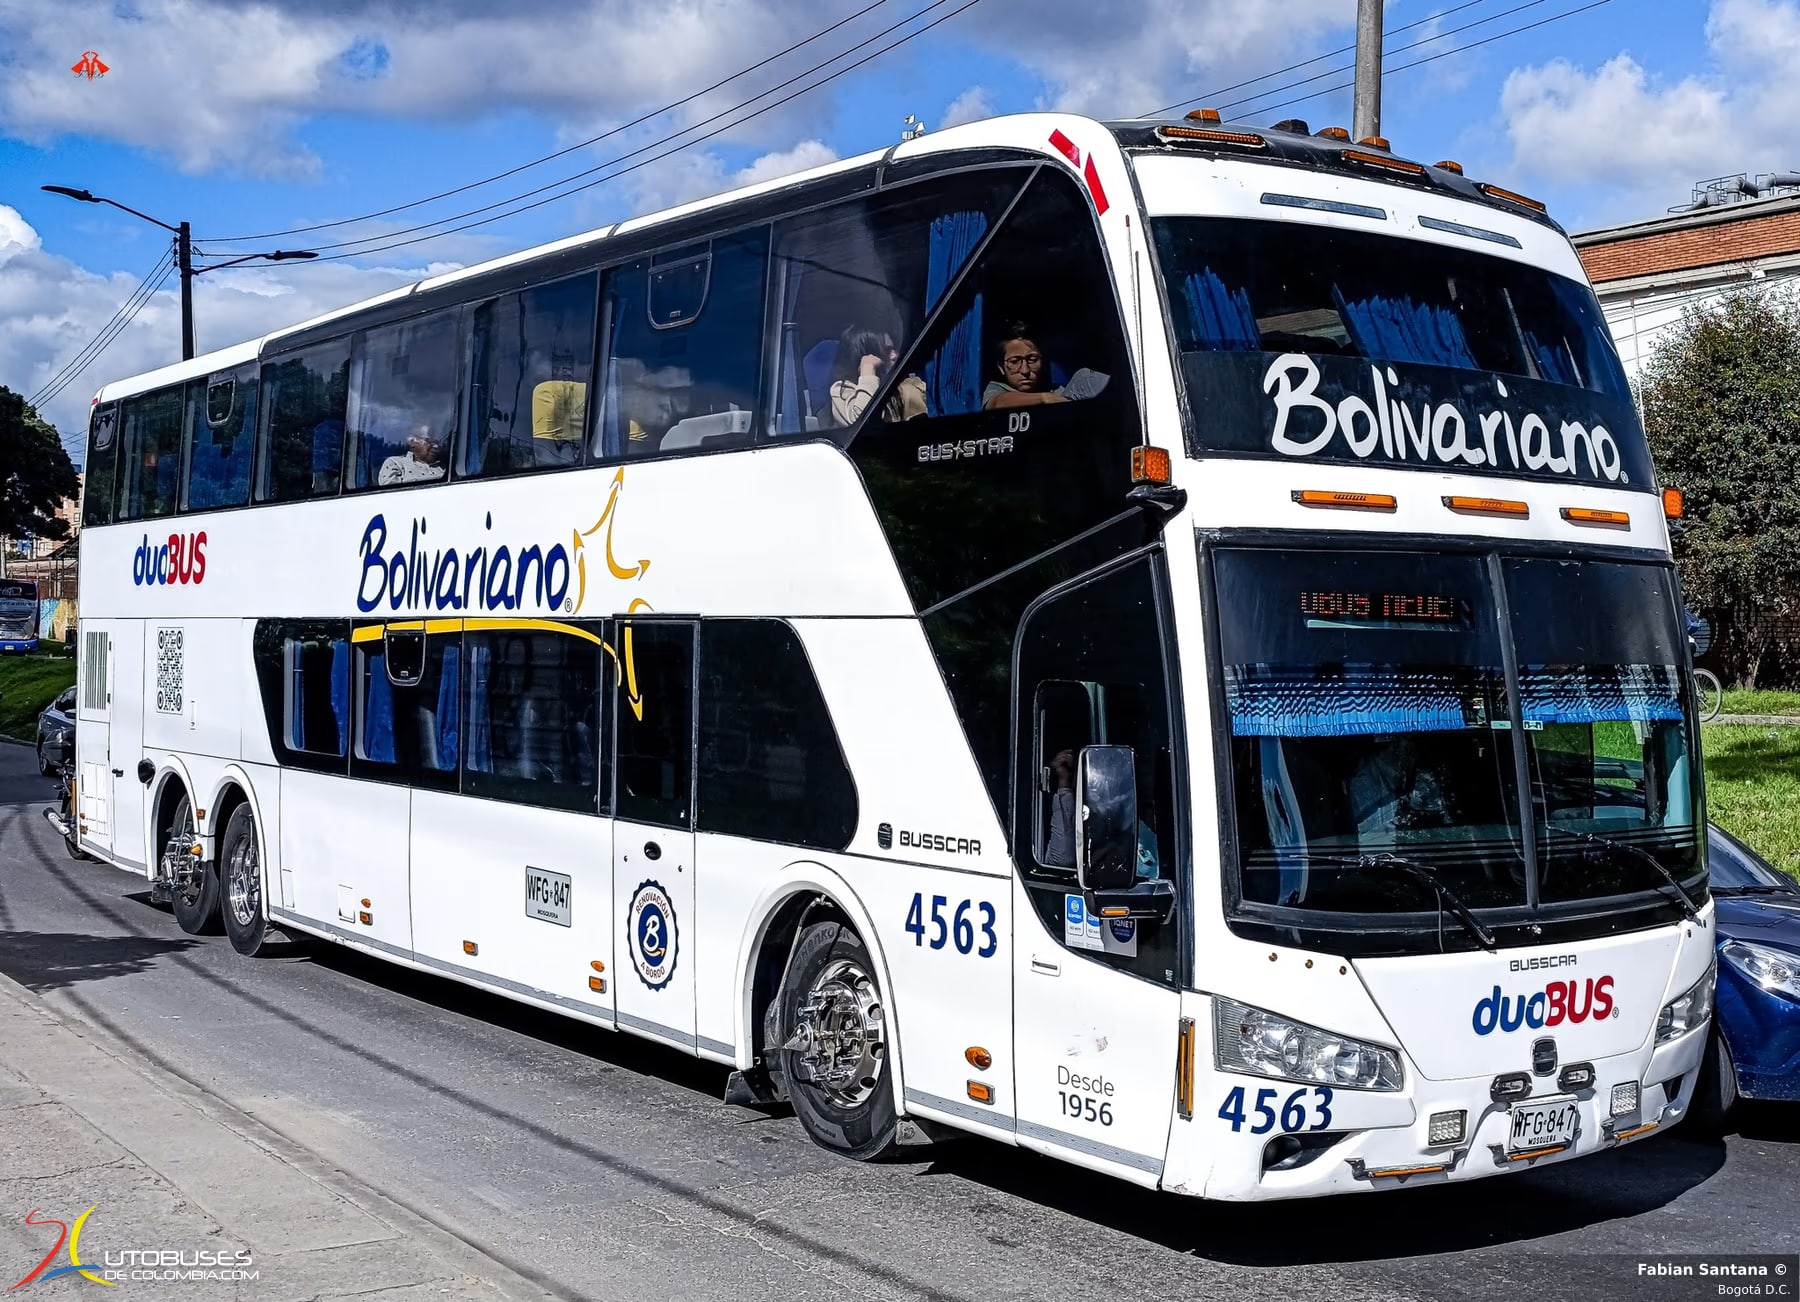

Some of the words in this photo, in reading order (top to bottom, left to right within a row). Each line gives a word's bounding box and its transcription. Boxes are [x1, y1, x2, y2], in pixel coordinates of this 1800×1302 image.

[1008, 412, 1030, 432] DD
[1263, 352, 1621, 481] Bolivariano
[133, 531, 208, 586] duoBUS
[357, 511, 570, 613] Bolivariano
[900, 830, 981, 856] BUSSCAR
[904, 892, 997, 958] 4563
[645, 966, 666, 979] BORDO
[1510, 954, 1577, 972] BUSSCAR
[1472, 975, 1615, 1036] duoBUS
[1057, 1065, 1115, 1097] Desde
[1058, 1091, 1113, 1126] 1956
[1217, 1086, 1334, 1134] 4563
